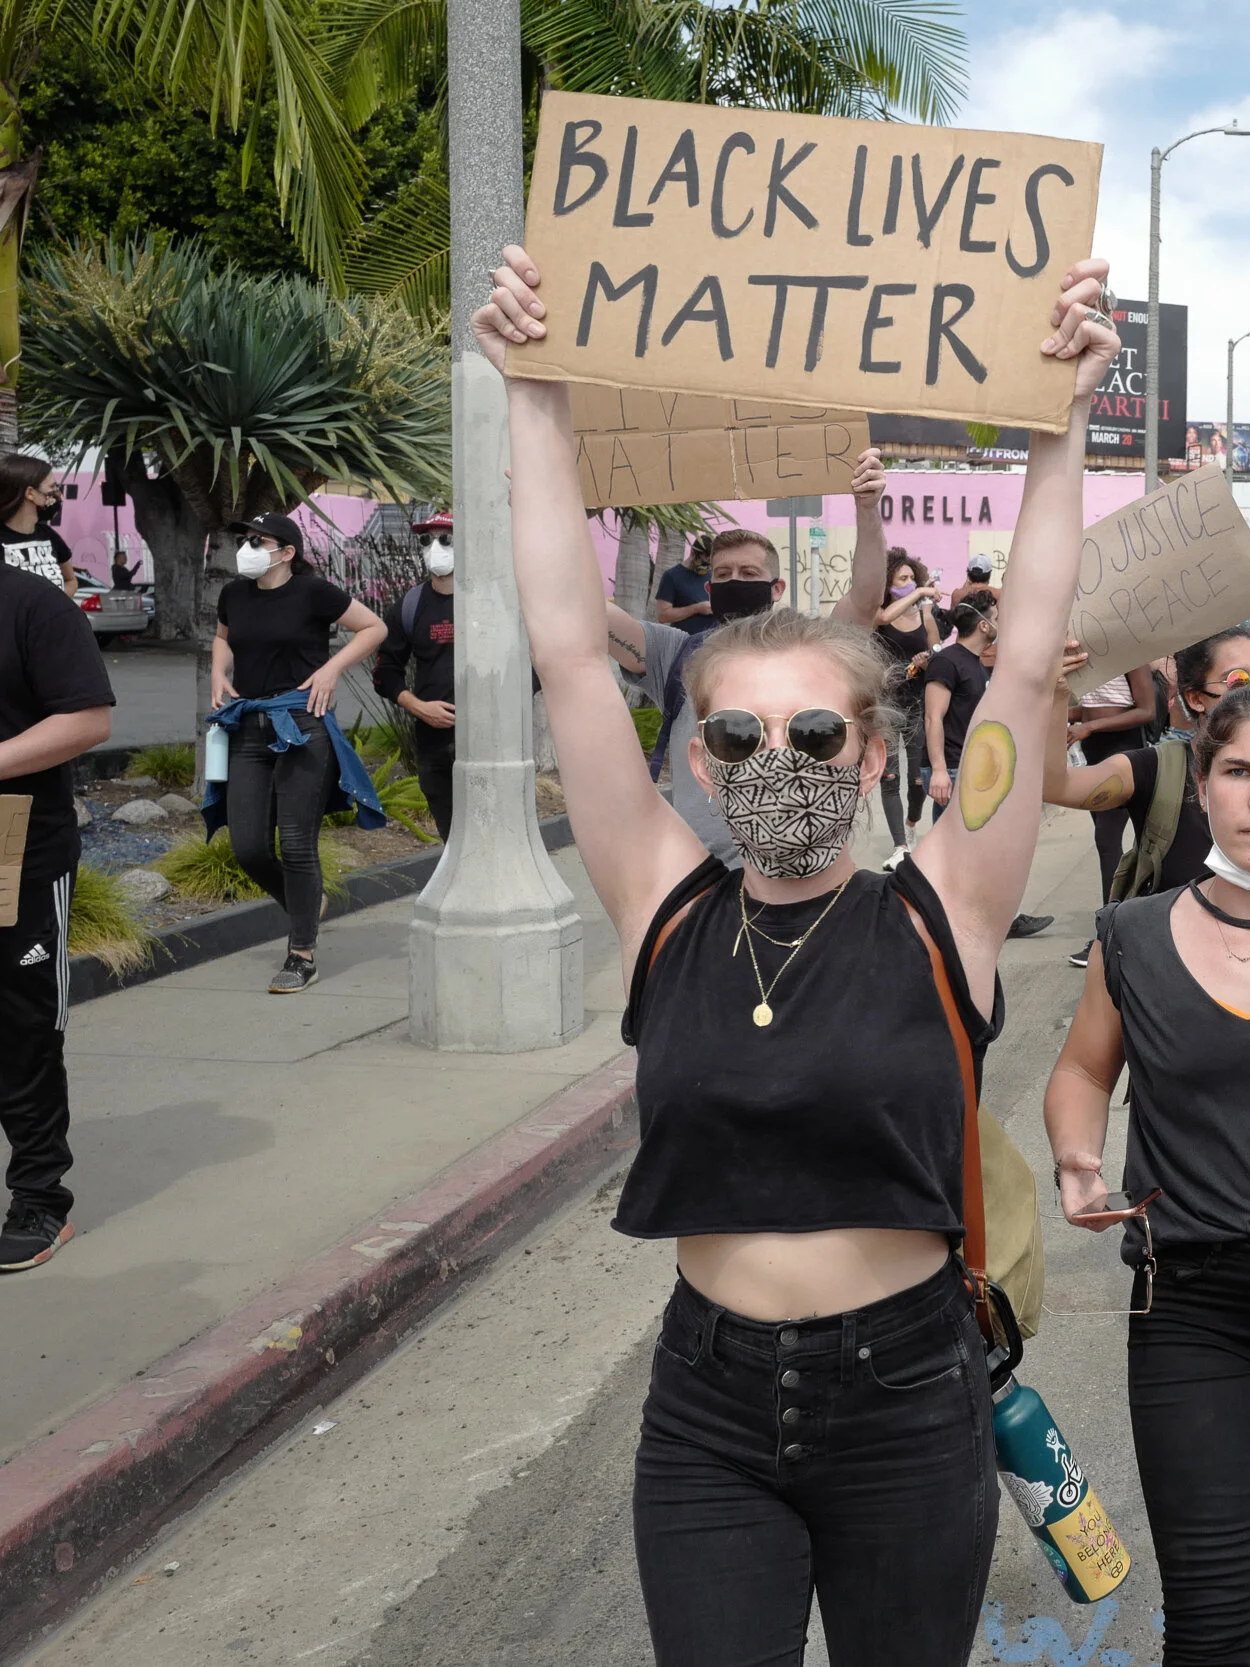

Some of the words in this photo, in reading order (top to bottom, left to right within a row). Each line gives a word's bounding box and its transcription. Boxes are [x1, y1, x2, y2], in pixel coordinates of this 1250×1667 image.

[553, 118, 820, 241] BLACK
[846, 144, 1076, 279] LIVES
[576, 261, 989, 386] MATTER
[1091, 432, 1119, 444] MARCH
[1122, 434, 1133, 446] 20
[880, 494, 993, 524] ORELLA
[1110, 474, 1236, 573] JUSTICE
[1108, 552, 1230, 645] PEACE
[19, 952, 51, 966] adidas
[1079, 1510, 1102, 1537] YOU
[1096, 1539, 1121, 1571] HERE
